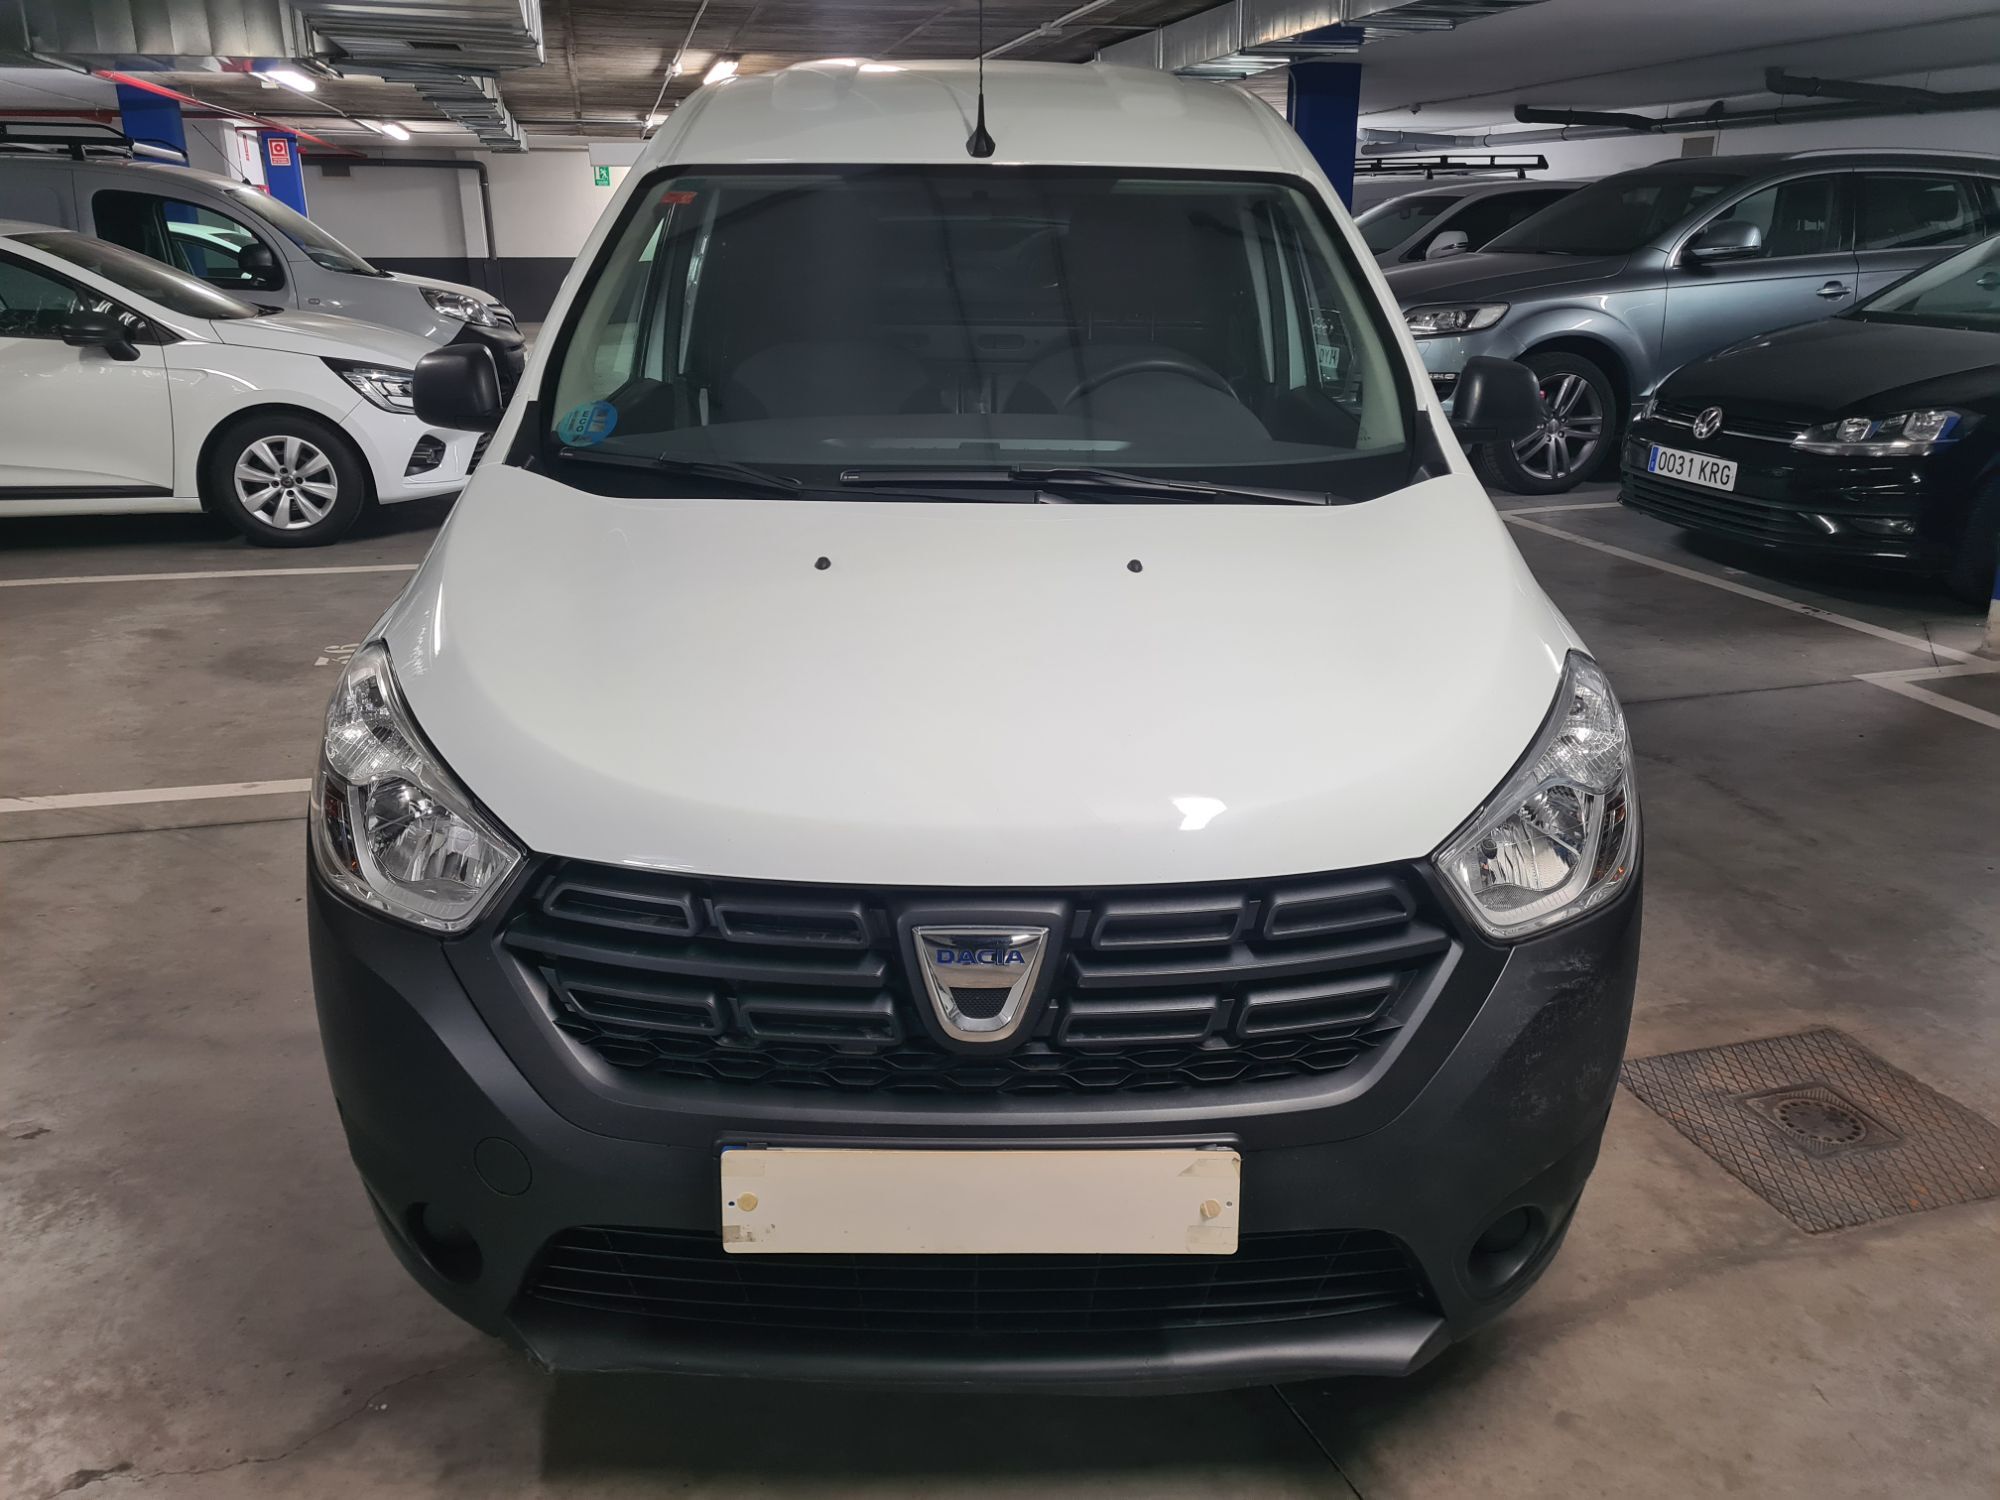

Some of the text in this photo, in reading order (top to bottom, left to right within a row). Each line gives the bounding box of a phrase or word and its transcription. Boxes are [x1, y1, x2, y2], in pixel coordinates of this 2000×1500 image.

[1658, 451, 1731, 485] 0031 KRG
[936, 949, 1025, 965] DACIA
